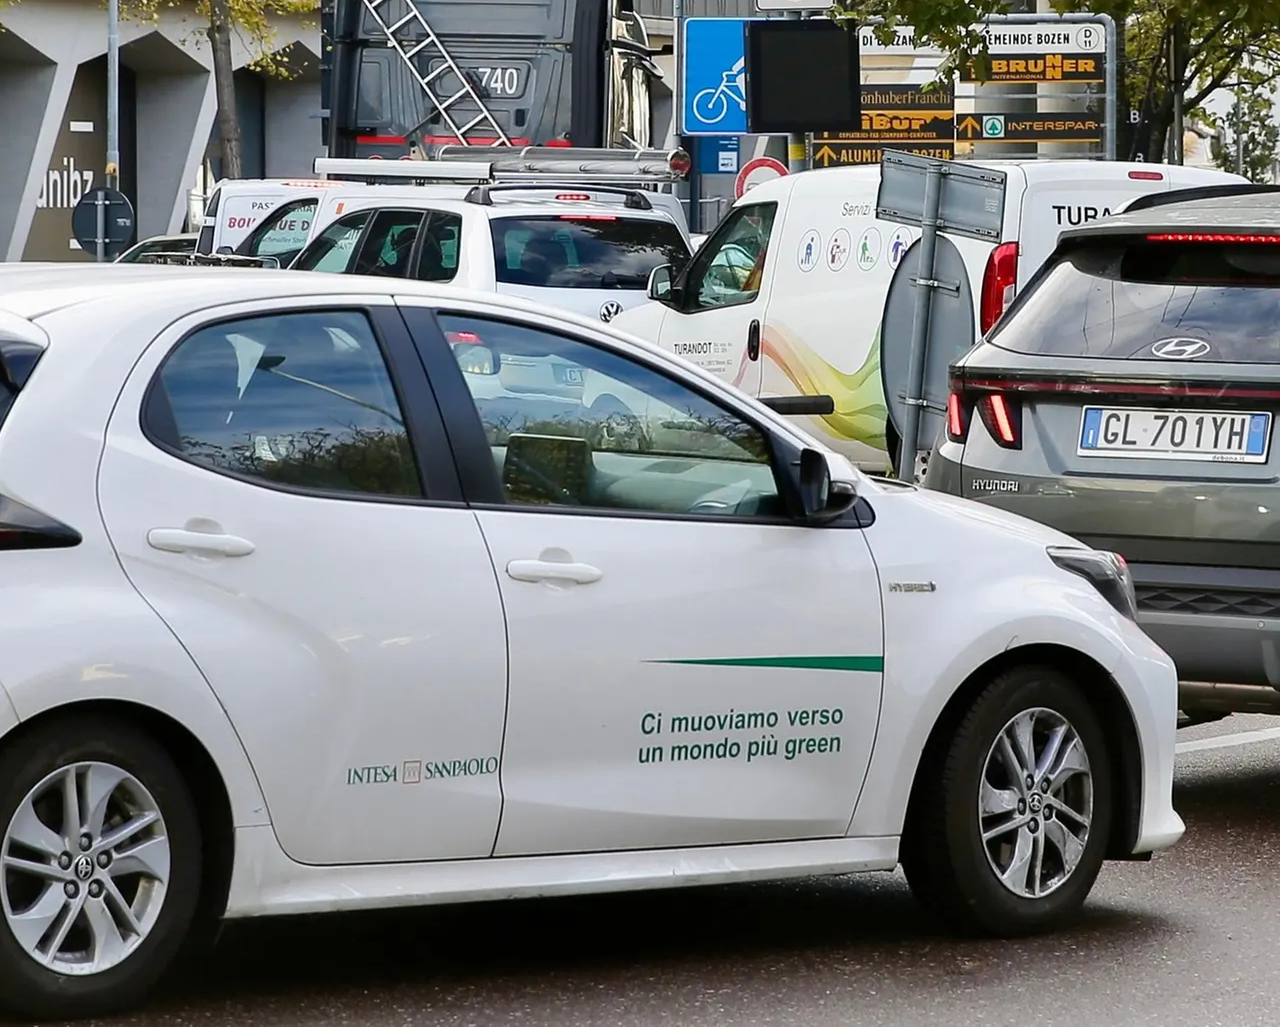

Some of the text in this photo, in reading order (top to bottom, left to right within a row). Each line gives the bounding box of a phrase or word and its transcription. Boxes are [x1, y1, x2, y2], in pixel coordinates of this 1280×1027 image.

[988, 32, 1070, 45] EMEINDE BOZEN
[1084, 29, 1092, 38] D
[1084, 40, 1092, 48] 11
[478, 68, 518, 95] 740
[861, 91, 951, 105] önhuberFranchi
[861, 113, 926, 130] iBur
[1008, 121, 1096, 131] INTERSPAR
[841, 202, 871, 217] Servizi
[673, 342, 713, 355] TURANDOT
[1103, 412, 1137, 445] GL
[1150, 414, 1246, 450] 701YH
[972, 479, 1019, 492] HYUNDAI
[640, 708, 843, 735] Ci muoviamo verso
[638, 734, 841, 763] un mondo più green
[346, 756, 498, 785] INTESA SANPAOLO
